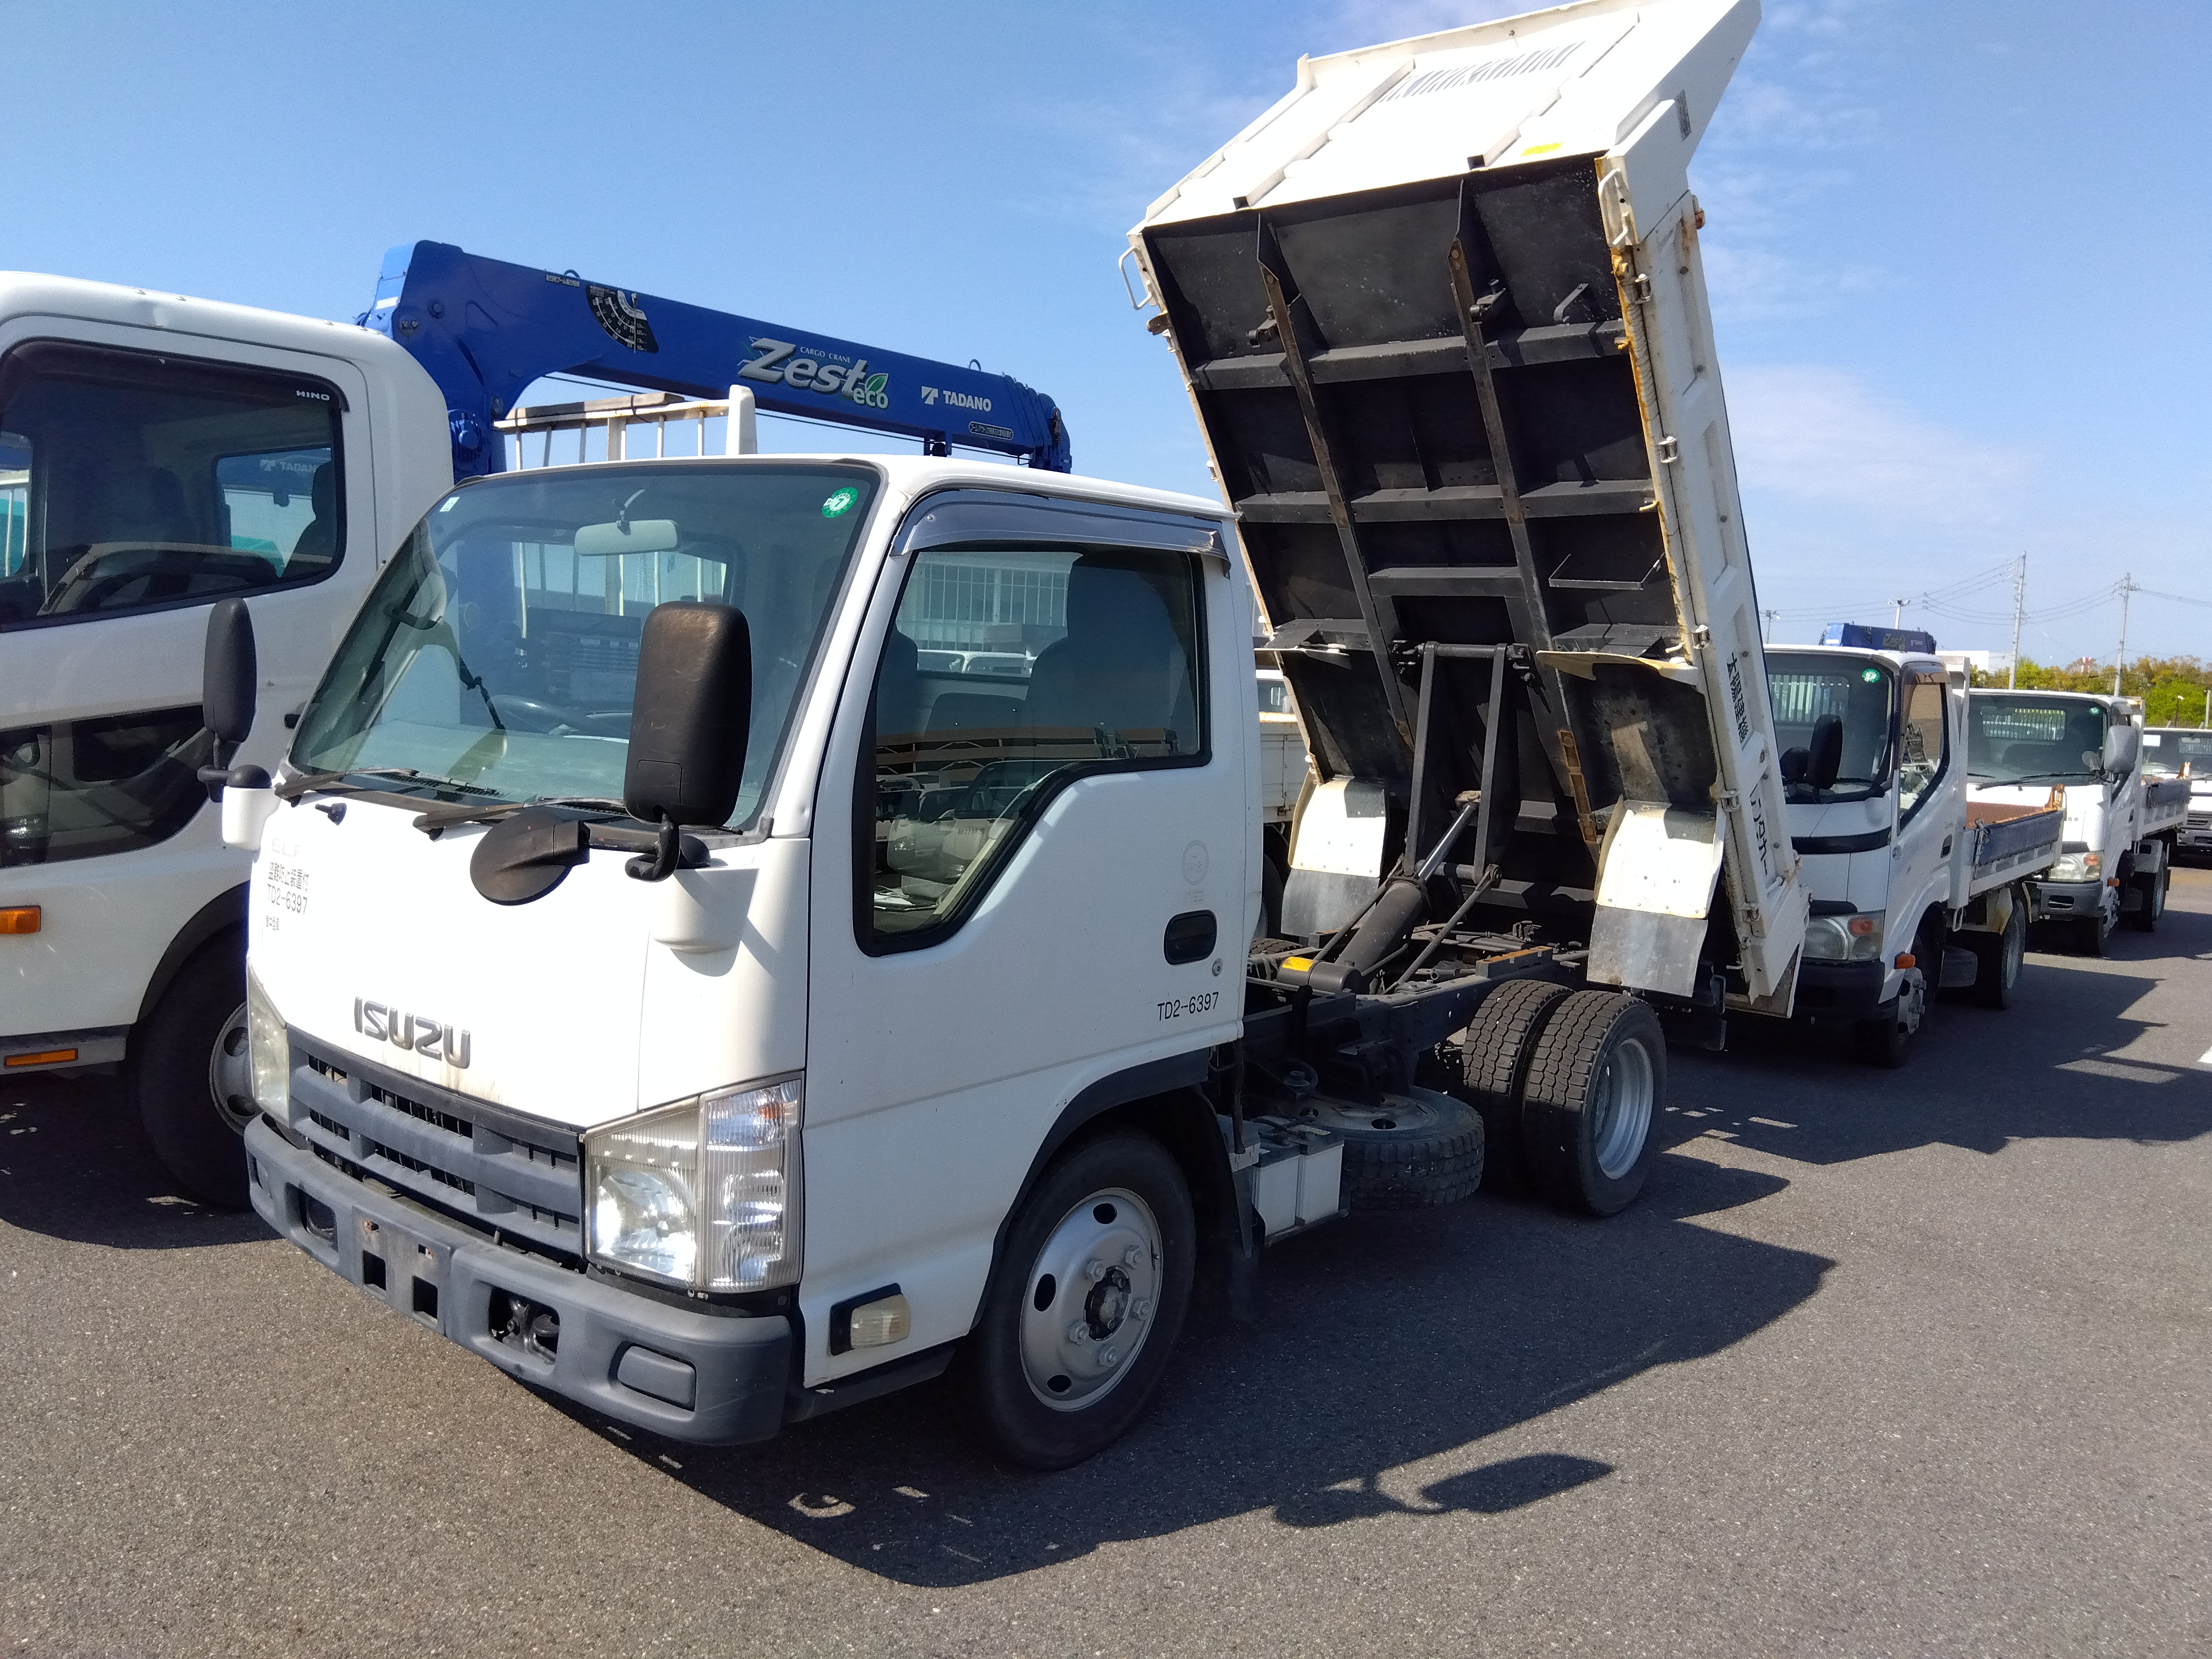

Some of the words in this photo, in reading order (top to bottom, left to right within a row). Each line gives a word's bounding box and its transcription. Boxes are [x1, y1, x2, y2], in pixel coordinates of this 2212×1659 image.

[800, 347, 825, 357] CARGO
[828, 353, 851, 363] CRANE
[738, 338, 867, 397] Zest
[296, 390, 330, 401] HINO
[853, 387, 889, 409] eco
[943, 390, 992, 412] TADANO
[280, 462, 317, 473] TADAN
[834, 498, 844, 507] 7
[1727, 652, 1748, 743] 太陽建機
[272, 837, 304, 858] ELF
[267, 884, 307, 915] TD2-6397
[1157, 991, 1219, 1021] TD2-6397
[354, 996, 471, 1069] ISUZU
